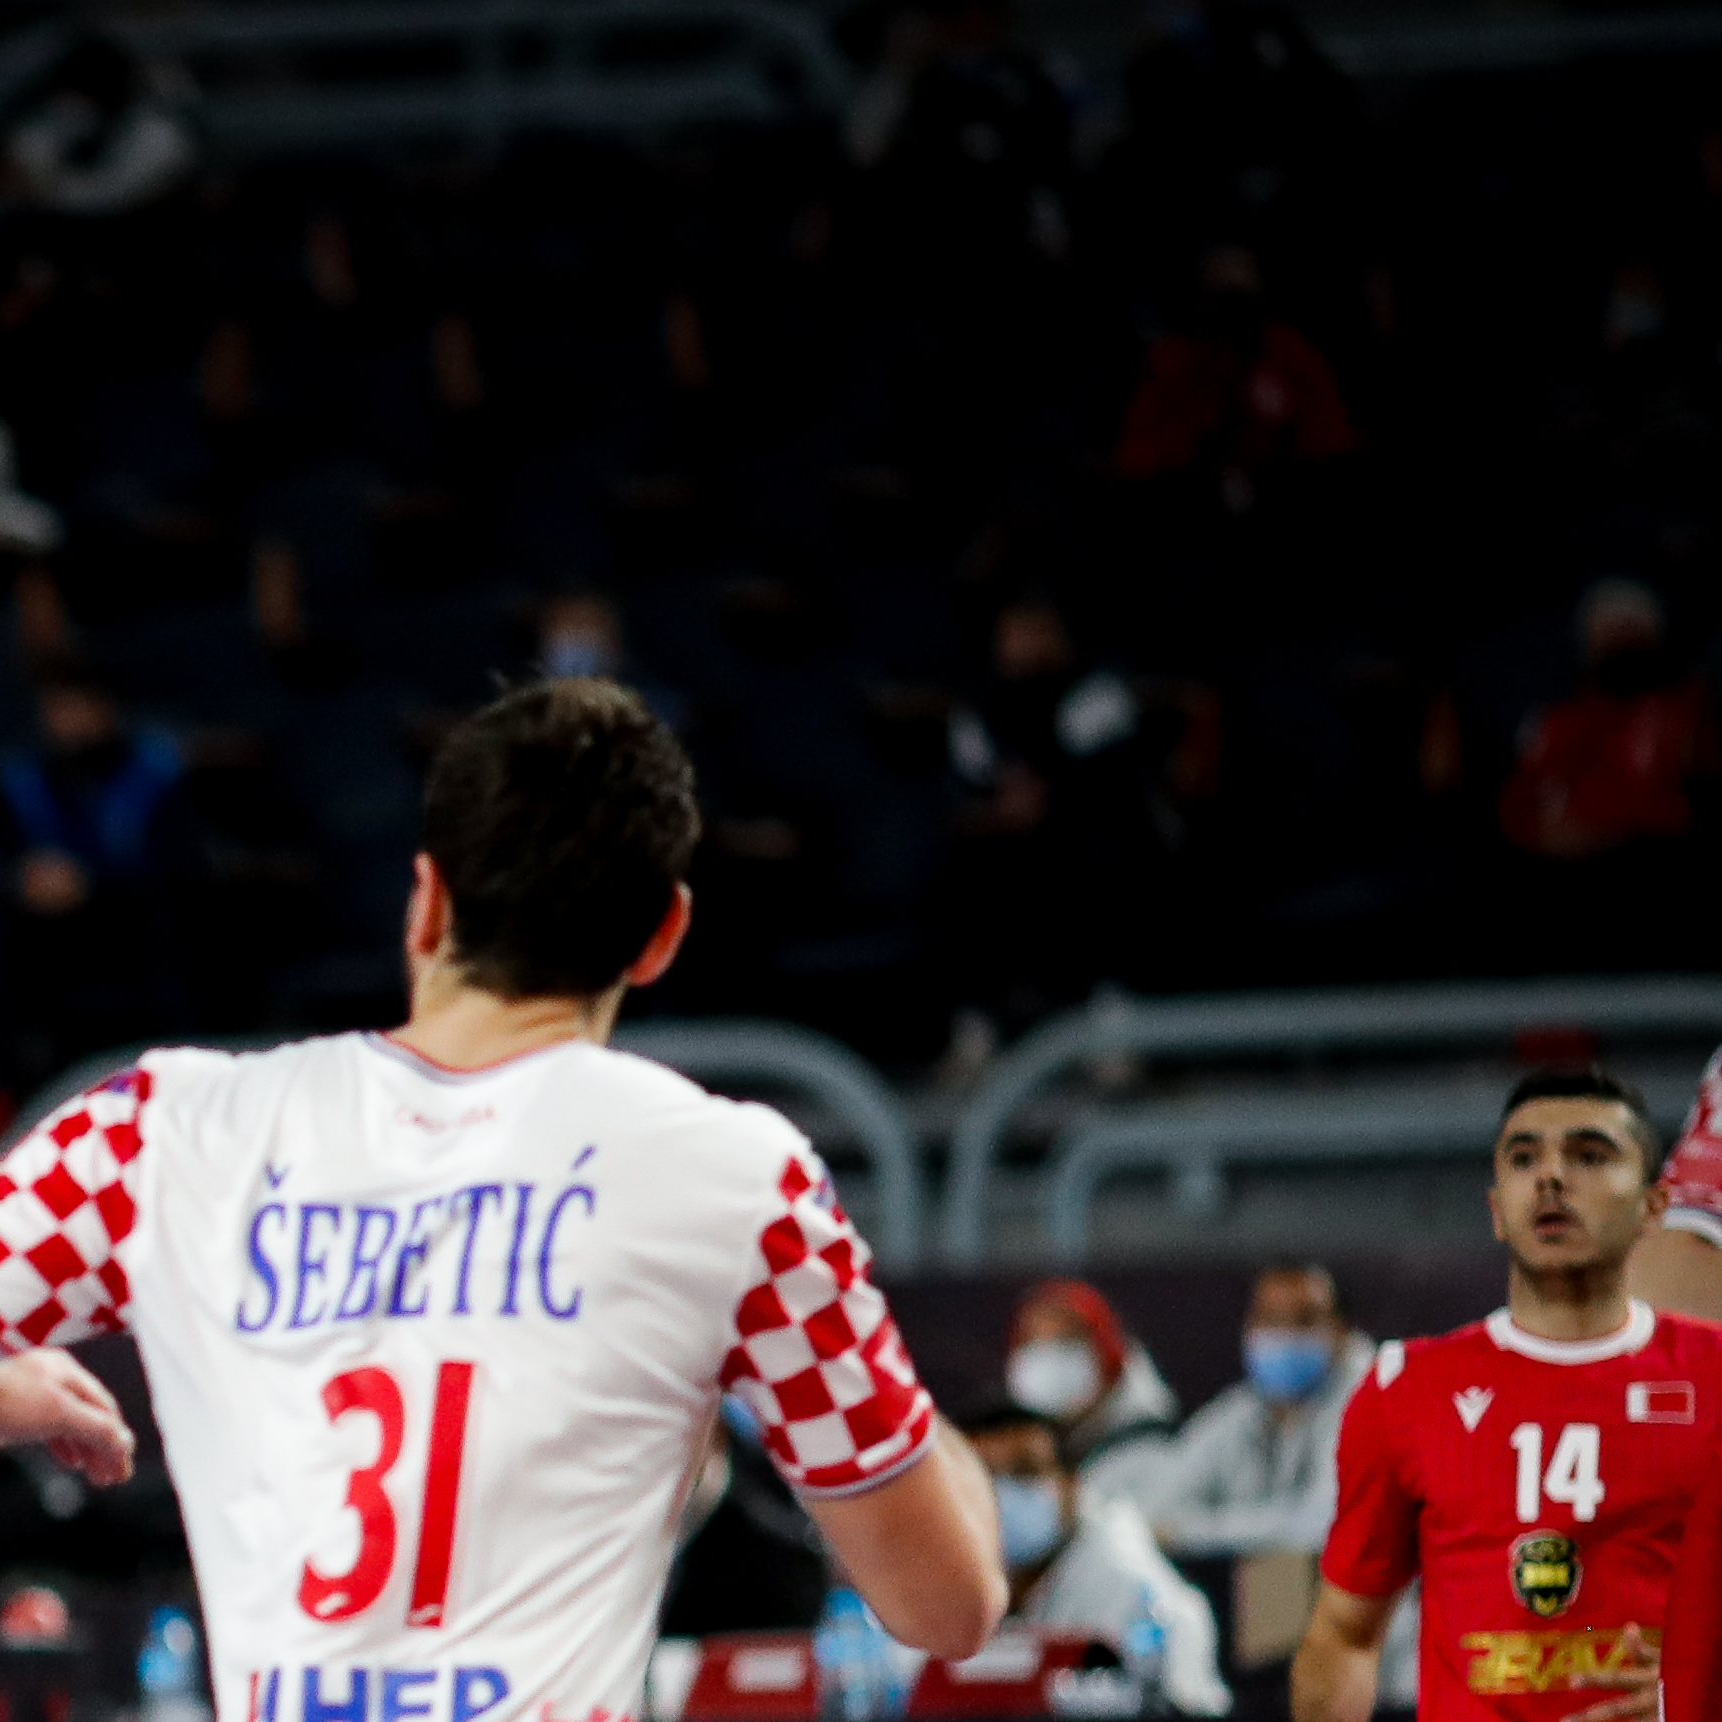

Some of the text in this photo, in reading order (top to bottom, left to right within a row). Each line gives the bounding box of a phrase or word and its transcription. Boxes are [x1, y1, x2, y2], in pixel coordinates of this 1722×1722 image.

[236, 1145, 596, 1333] ŠEBETIĆ
[296, 1361, 481, 1629] 31
[1510, 1421, 1605, 1523] 14
